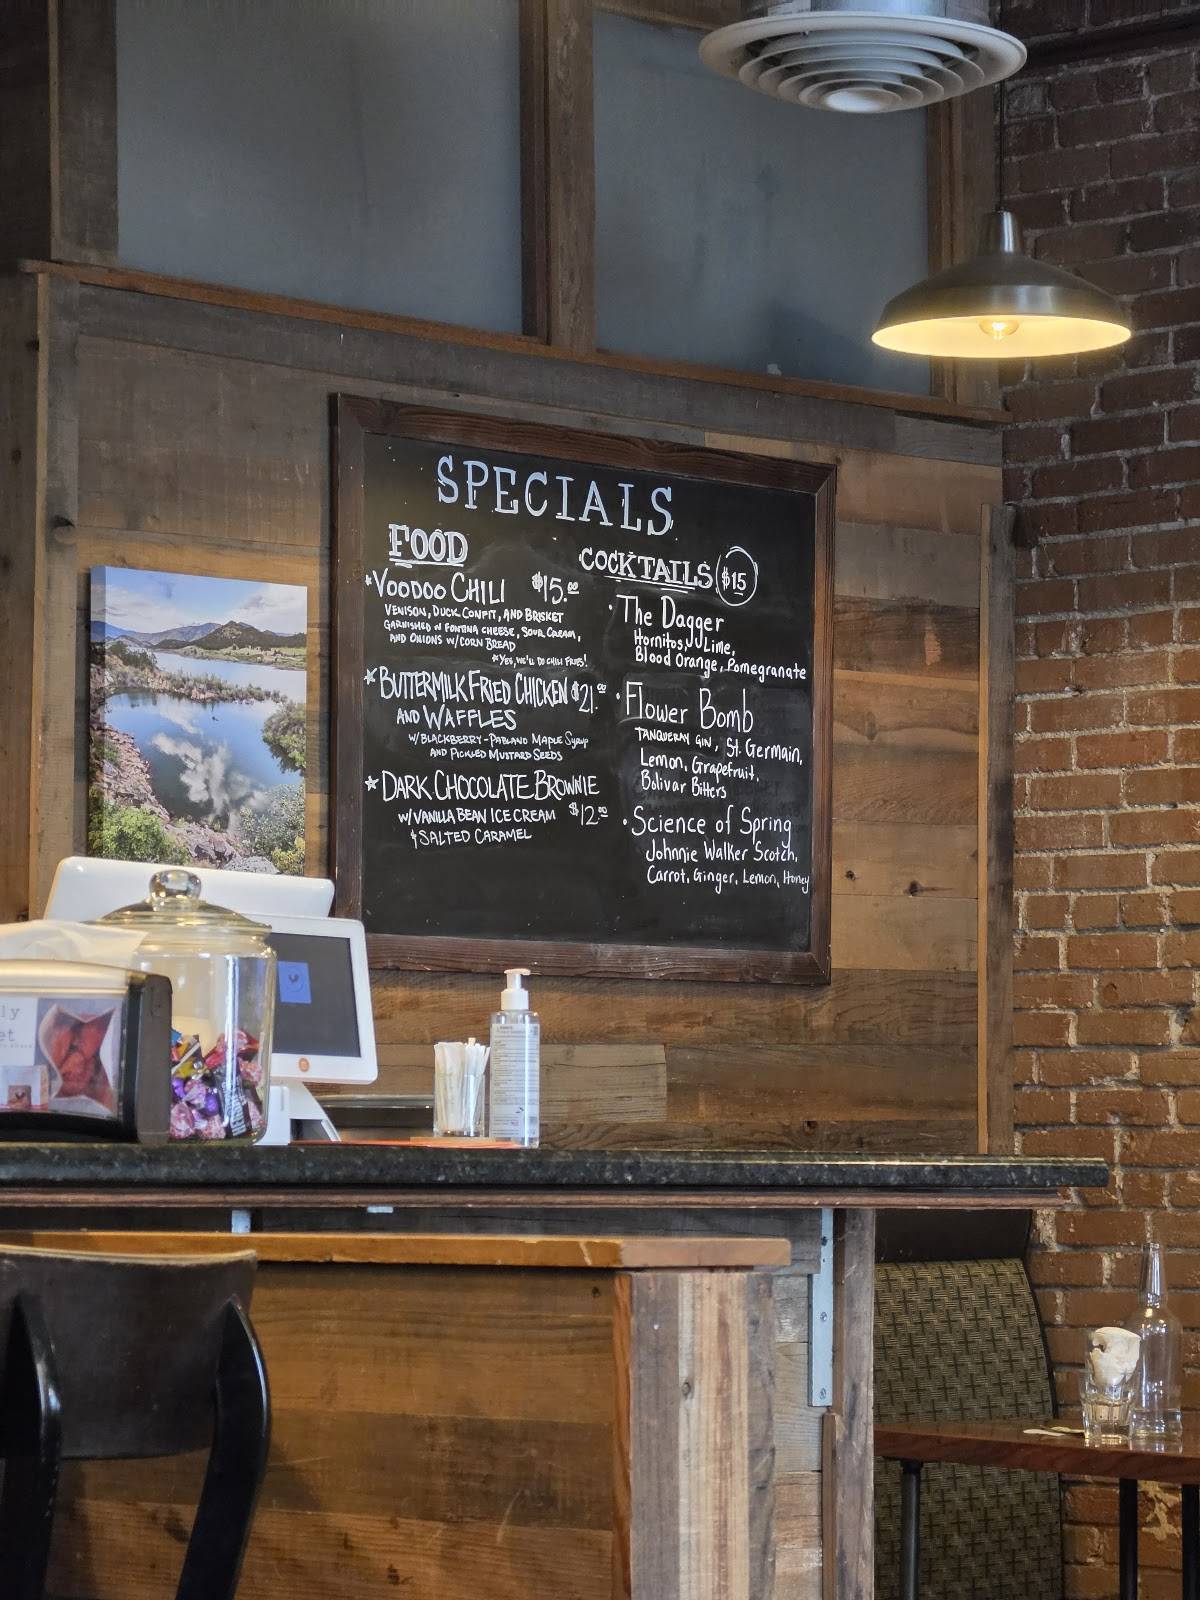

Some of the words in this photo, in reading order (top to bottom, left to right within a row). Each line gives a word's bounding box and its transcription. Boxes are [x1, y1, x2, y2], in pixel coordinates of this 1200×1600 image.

[437, 454, 674, 536] SPECIALS
[388, 523, 468, 564] FOOD
[579, 547, 714, 589] COCKTAILS
[721, 565, 748, 591] $15
[372, 568, 447, 600] VOODOO
[451, 571, 505, 605] CHILI
[384, 603, 431, 619] VENISON,
[432, 604, 461, 618] DUCK
[462, 606, 501, 622] CONFIT,
[503, 608, 523, 622] AND
[524, 607, 564, 623] BRISKET
[616, 594, 653, 627] The
[661, 595, 725, 648] Dagger
[383, 619, 432, 632] GARNISHED
[481, 626, 520, 639] CHEESE,
[521, 626, 546, 638] SOUR
[389, 633, 407, 644] AND
[409, 632, 443, 645] ONIONS
[485, 637, 516, 652] BREAD
[634, 628, 687, 651] Hornitos,
[703, 637, 736, 656] Lime,
[635, 645, 671, 667] Blood
[675, 652, 723, 678] Orange,
[727, 658, 807, 682] Pomegranate
[379, 665, 468, 702] BUTTERMILK
[468, 669, 510, 705] FRIED
[514, 672, 568, 708] CHICKEN
[396, 707, 420, 725] AND
[422, 704, 518, 731] WAFFLES
[625, 681, 689, 724] Flower
[699, 687, 754, 733] Bomb
[531, 733, 563, 749] MAPLE
[635, 726, 690, 746] TANQUERAY
[430, 747, 448, 758] AND
[450, 748, 487, 761] PICKLED
[489, 749, 532, 762] MUSTARD
[533, 748, 563, 762] SEEDS
[640, 747, 688, 772] Lemon,
[726, 737, 742, 758] St.
[745, 738, 803, 766] Germain,
[382, 769, 433, 802] DARK
[434, 769, 534, 802] CHOCOLATE
[534, 769, 600, 801] BROWNIE
[641, 769, 687, 794] Bolivar
[691, 776, 727, 799] Bitters
[457, 807, 487, 825] BEAN
[490, 807, 513, 824] ICE
[513, 808, 556, 824] CREAM
[631, 805, 706, 837] Science
[715, 804, 734, 835] of
[739, 806, 792, 848] Spring
[474, 828, 532, 845] CARAMEL
[645, 838, 699, 864] Johnnie
[703, 838, 748, 862] Walker
[753, 840, 798, 863] Scotch,
[647, 865, 690, 885] Carrot,
[693, 867, 738, 894] Ginger,
[743, 868, 780, 888] Lemon,
[783, 869, 810, 894] Honey
